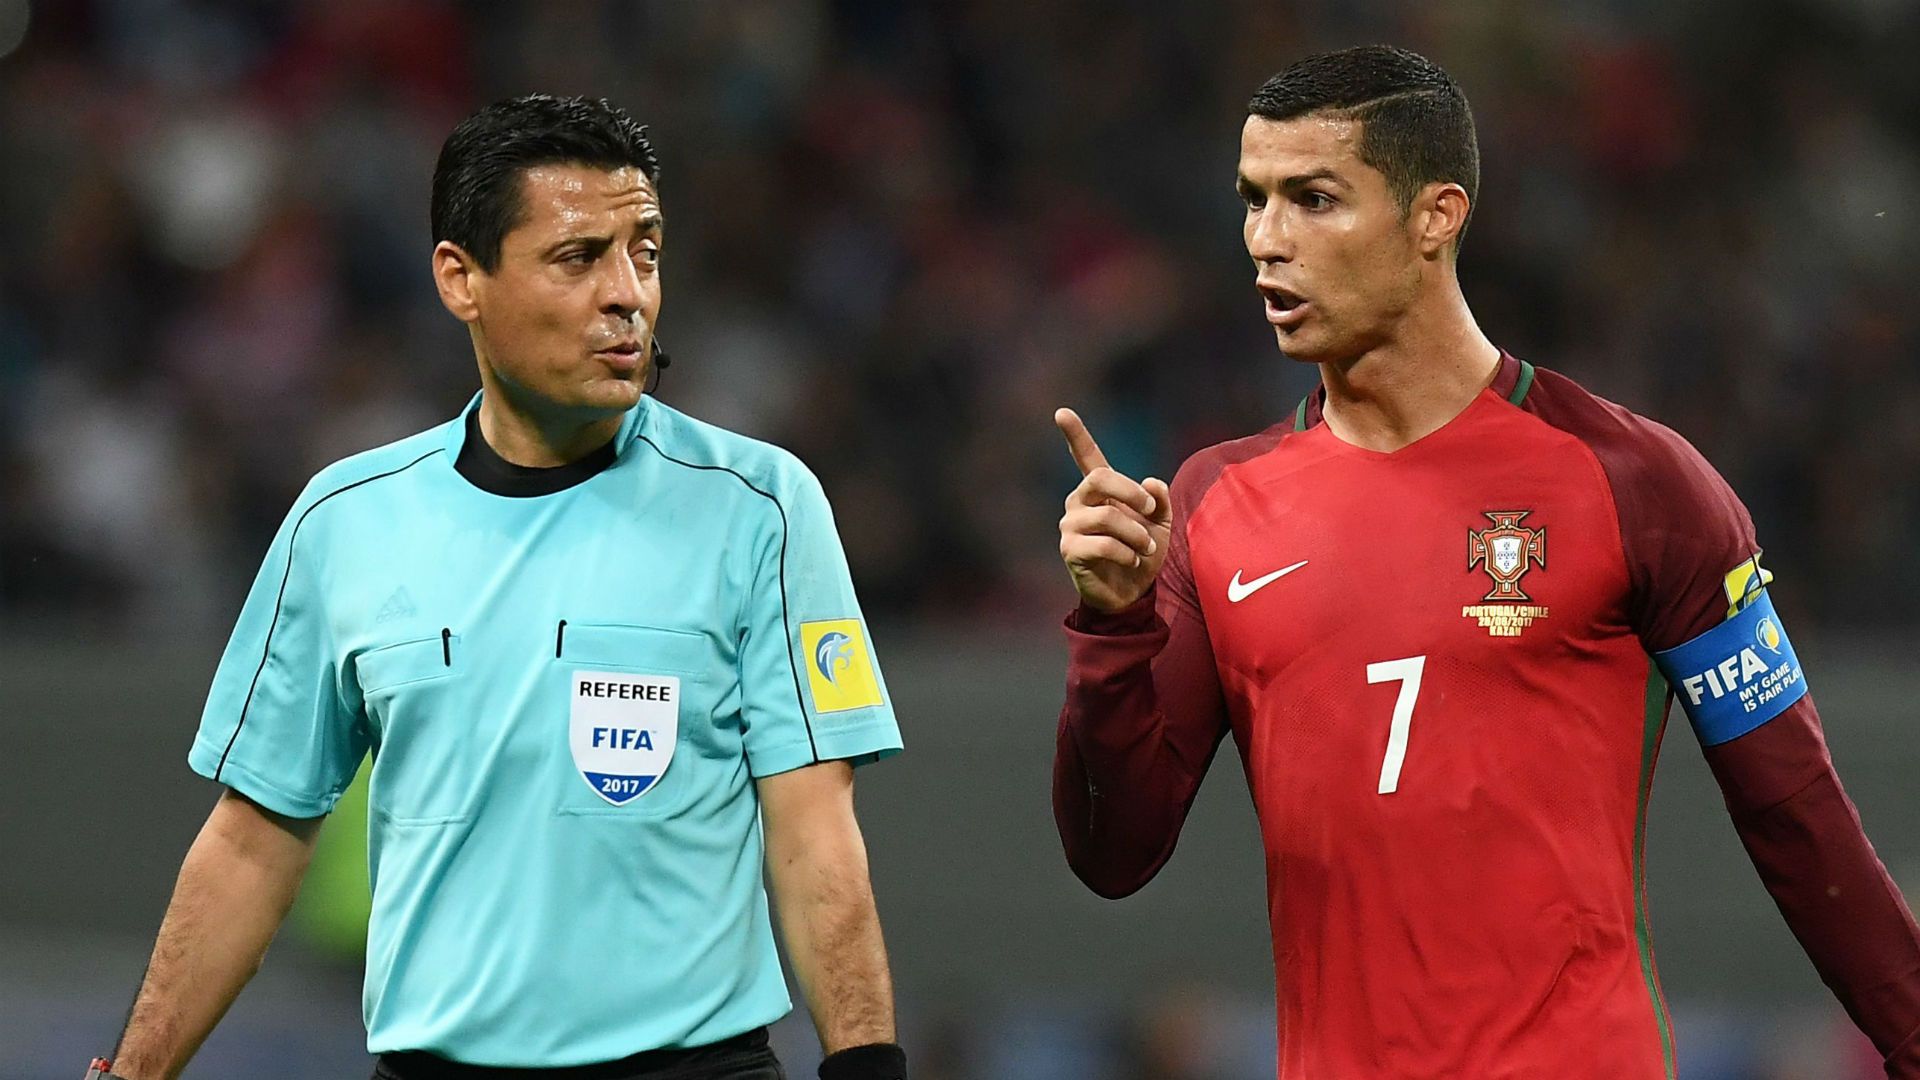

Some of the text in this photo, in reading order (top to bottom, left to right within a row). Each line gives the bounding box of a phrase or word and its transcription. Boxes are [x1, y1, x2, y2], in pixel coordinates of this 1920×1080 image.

[1489, 626, 1522, 636] KAZAN
[1682, 647, 1769, 706] FIFA
[1739, 661, 1791, 702] MY GAME
[579, 681, 671, 702] REFEREE
[1743, 699, 1757, 713] IS
[1758, 682, 1783, 705] FAIR
[1366, 655, 1426, 794] 7
[592, 727, 654, 751] FIFA
[601, 778, 639, 793] 2017
